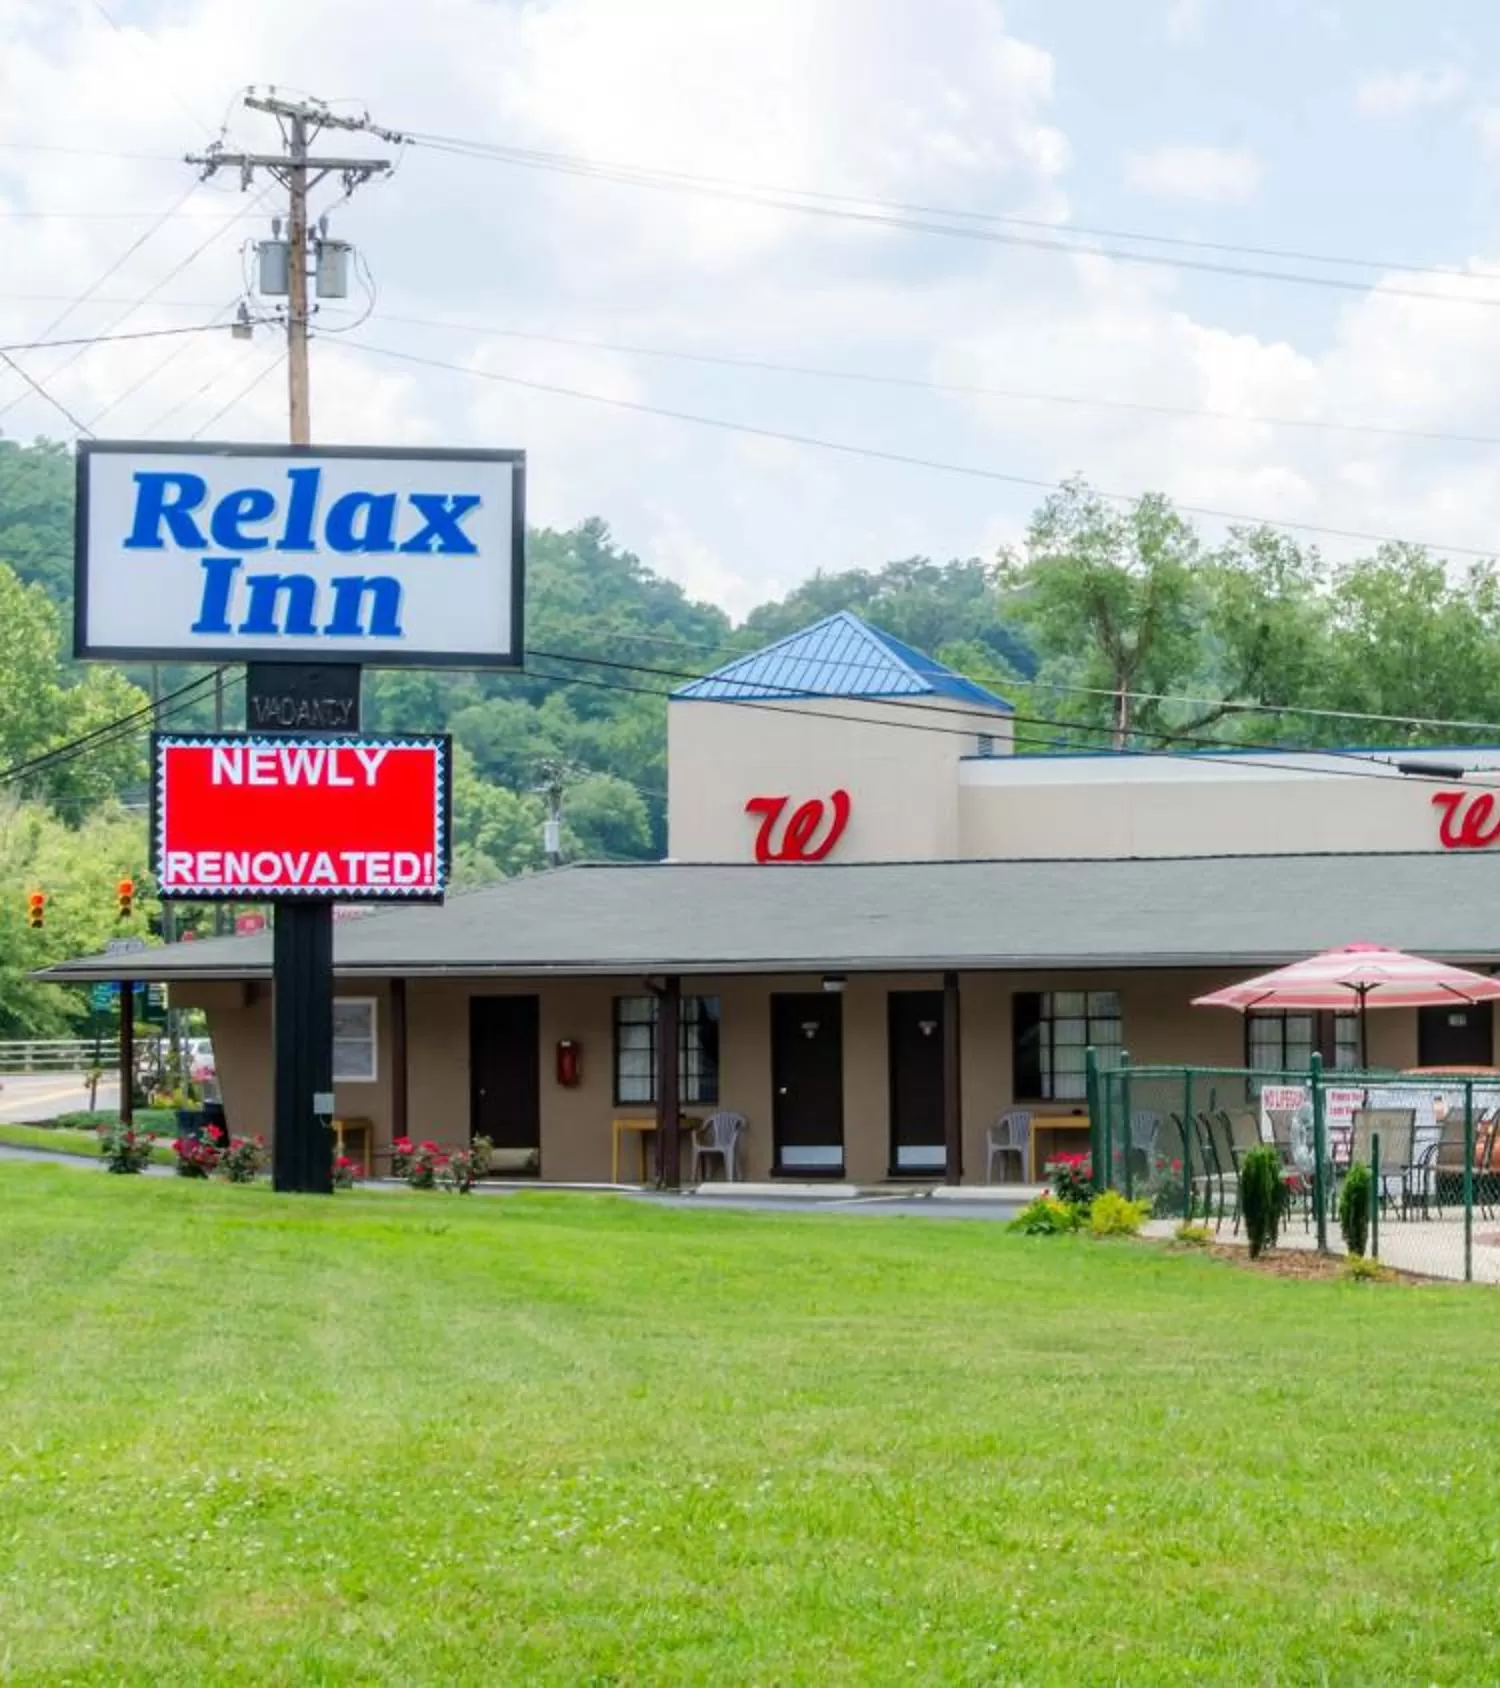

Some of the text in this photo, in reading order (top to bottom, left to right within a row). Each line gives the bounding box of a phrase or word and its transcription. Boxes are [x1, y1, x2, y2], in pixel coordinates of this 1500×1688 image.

[122, 467, 481, 554] Relax
[191, 557, 404, 638] Inn
[252, 697, 353, 725] VACANCY
[211, 748, 388, 787] NEWLY
[744, 788, 852, 864] W
[167, 851, 434, 884] RENOVATED!
